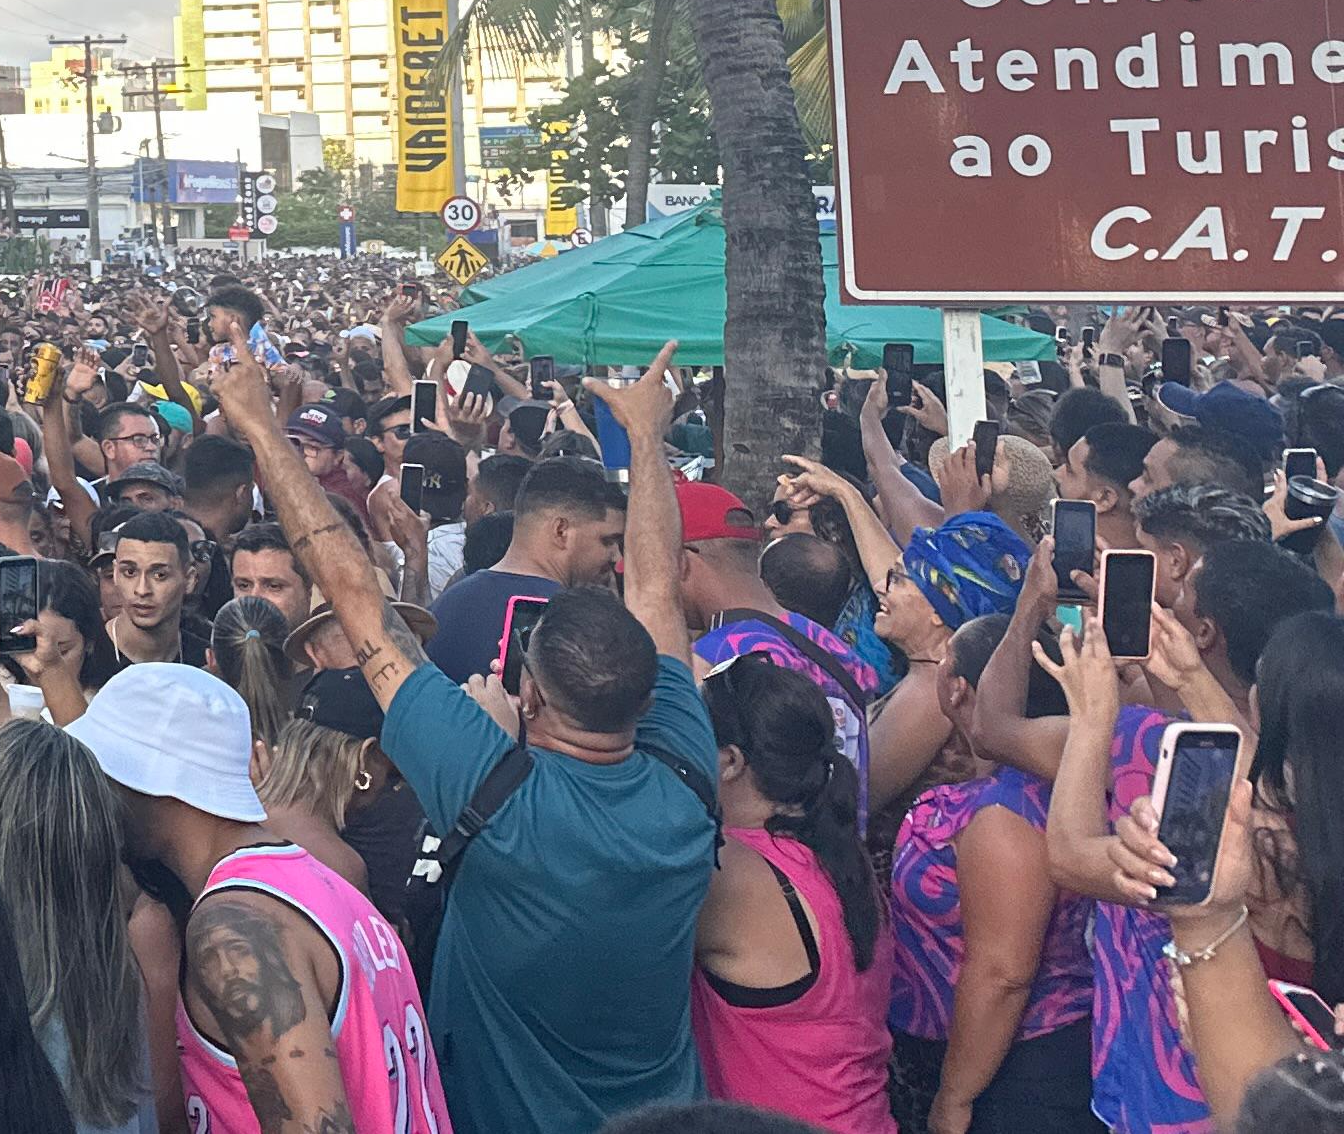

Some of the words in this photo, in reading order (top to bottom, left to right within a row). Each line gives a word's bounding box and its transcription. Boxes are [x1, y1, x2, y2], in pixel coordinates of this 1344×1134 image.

[883, 31, 1344, 95] Atendime
[950, 134, 1052, 178] ao
[448, 204, 474, 221] 30
[1089, 206, 1339, 263] C.A.T.
